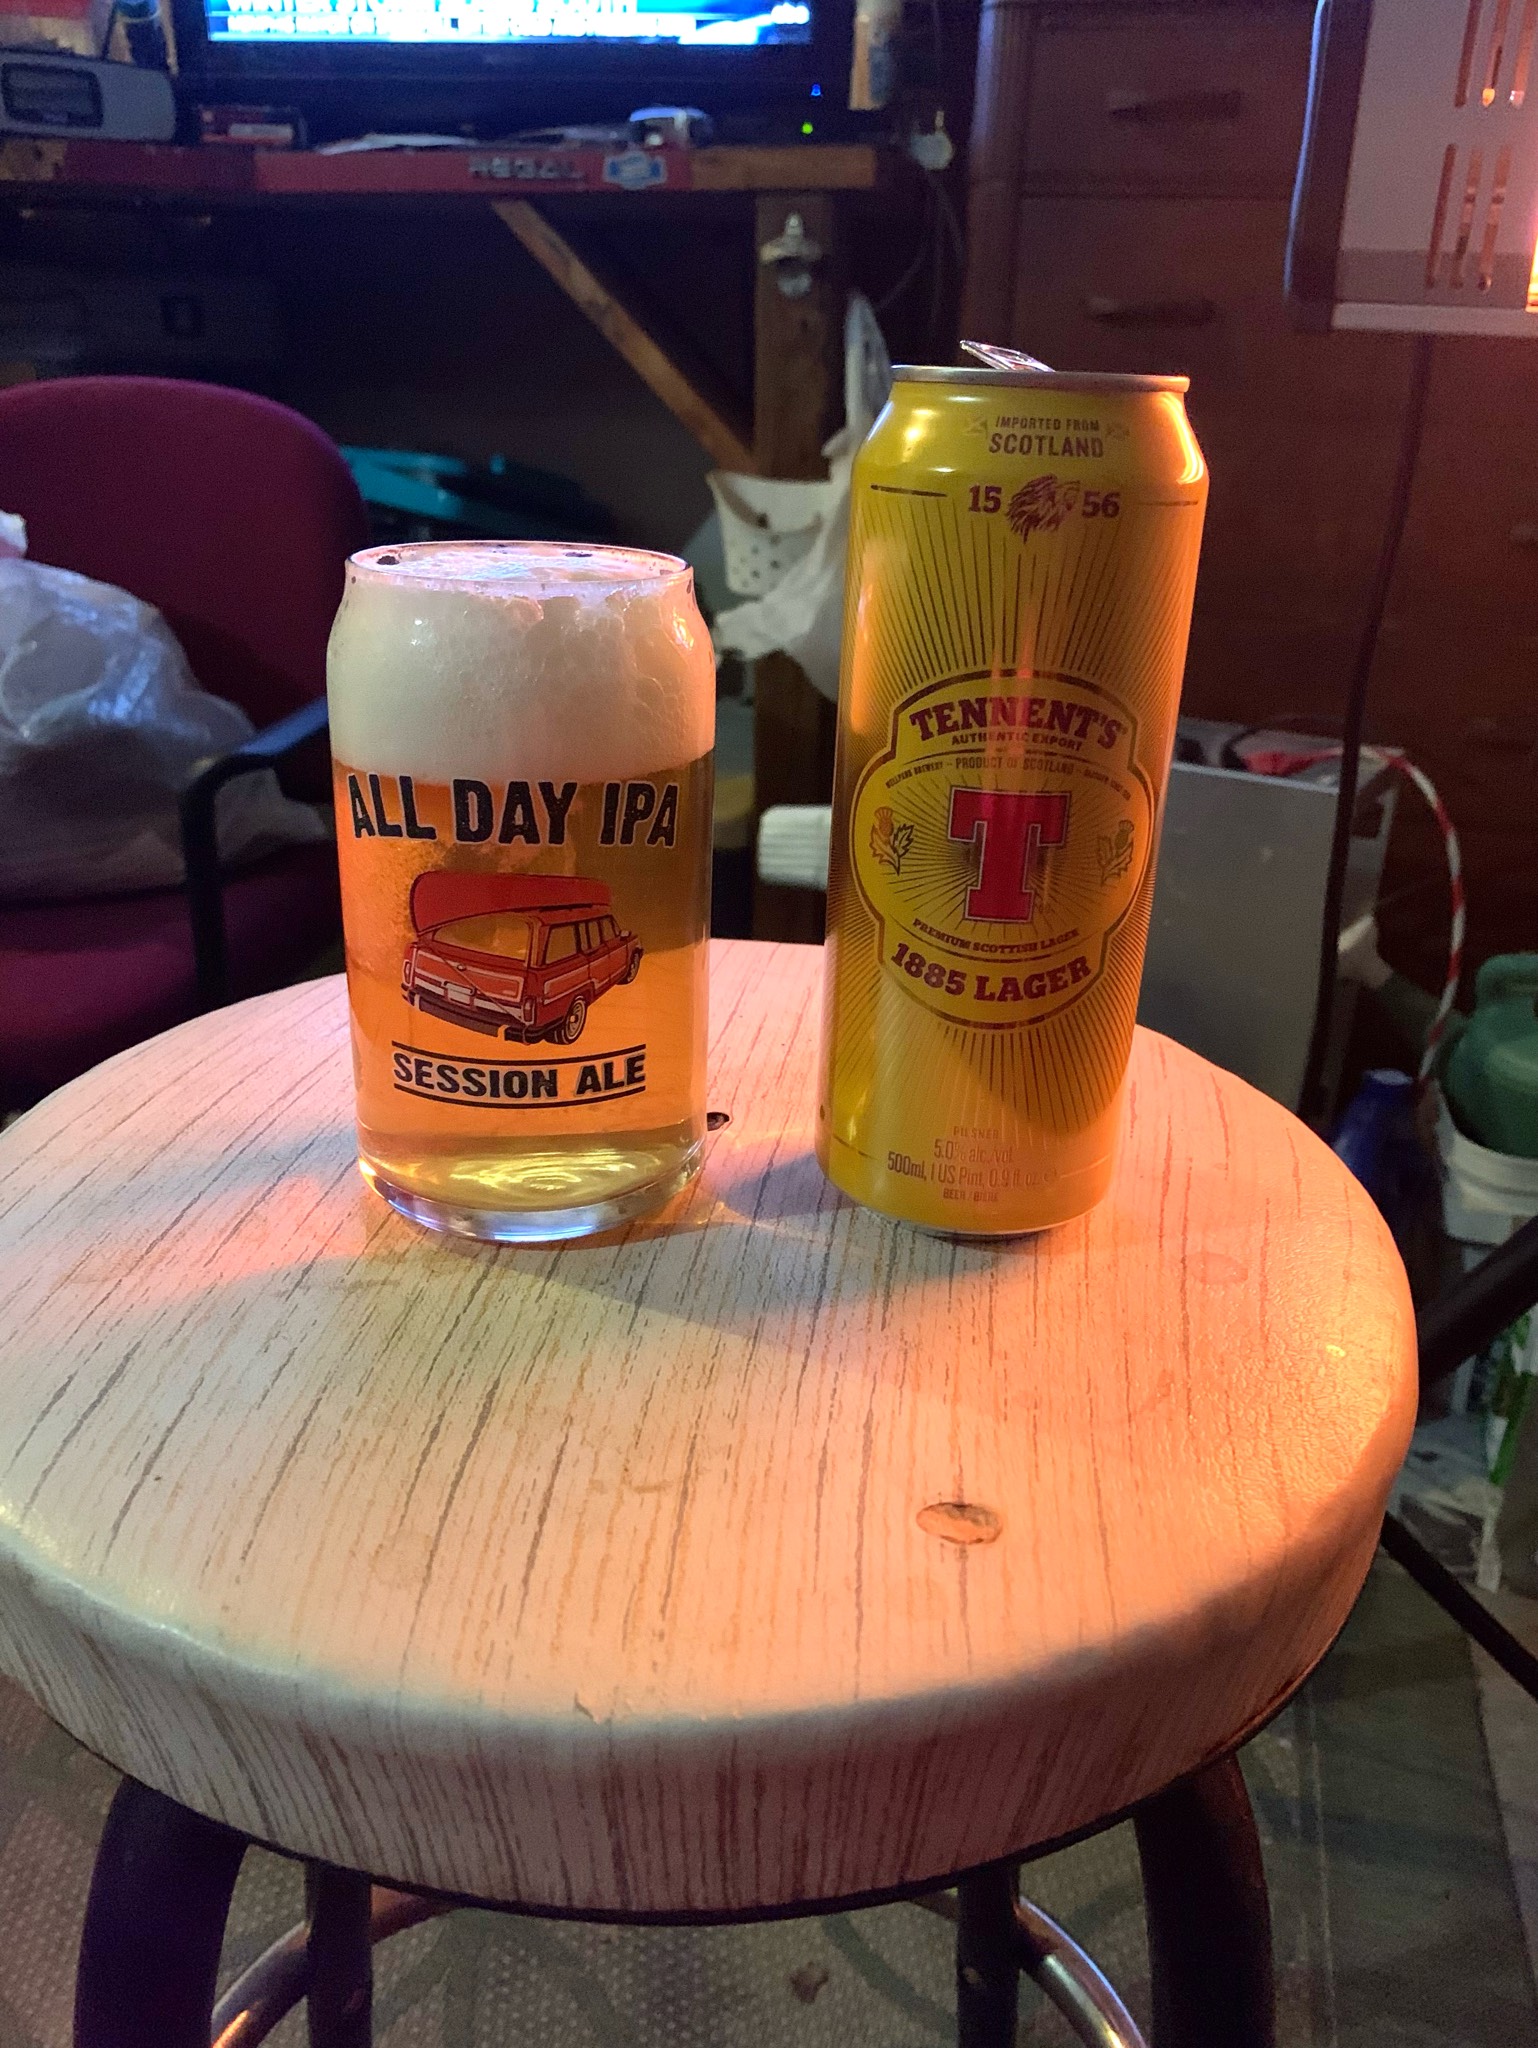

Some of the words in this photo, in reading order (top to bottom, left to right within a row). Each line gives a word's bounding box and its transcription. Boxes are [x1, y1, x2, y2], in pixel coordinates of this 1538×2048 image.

[995, 416, 1061, 431] IMPORTED
[1066, 419, 1100, 432] FROM
[988, 432, 1104, 458] SCOTLAND
[968, 485, 1003, 514] 15
[1081, 490, 1122, 519] 56
[909, 696, 1123, 749] TENNENT'S
[952, 732, 1028, 746] AUTHENTIC
[1031, 734, 1083, 751] EXPORT
[955, 757, 1003, 769] PRODUCT
[1023, 758, 1075, 776] SCOTLAND
[348, 774, 437, 840] ALL
[452, 778, 578, 845] DAY
[600, 781, 680, 848] IPA
[948, 786, 1072, 923] T
[912, 918, 971, 949] PREMIUM
[972, 942, 1038, 953] SCOTTISH
[1041, 928, 1080, 949] LAGER
[890, 942, 967, 996] 1885
[974, 956, 1092, 1002] LAGER
[393, 1051, 558, 1099] SESSION
[575, 1053, 646, 1096] ALE
[953, 1125, 999, 1139] PILSNER
[933, 1138, 966, 1161] 5.0%
[937, 1165, 956, 1185] US
